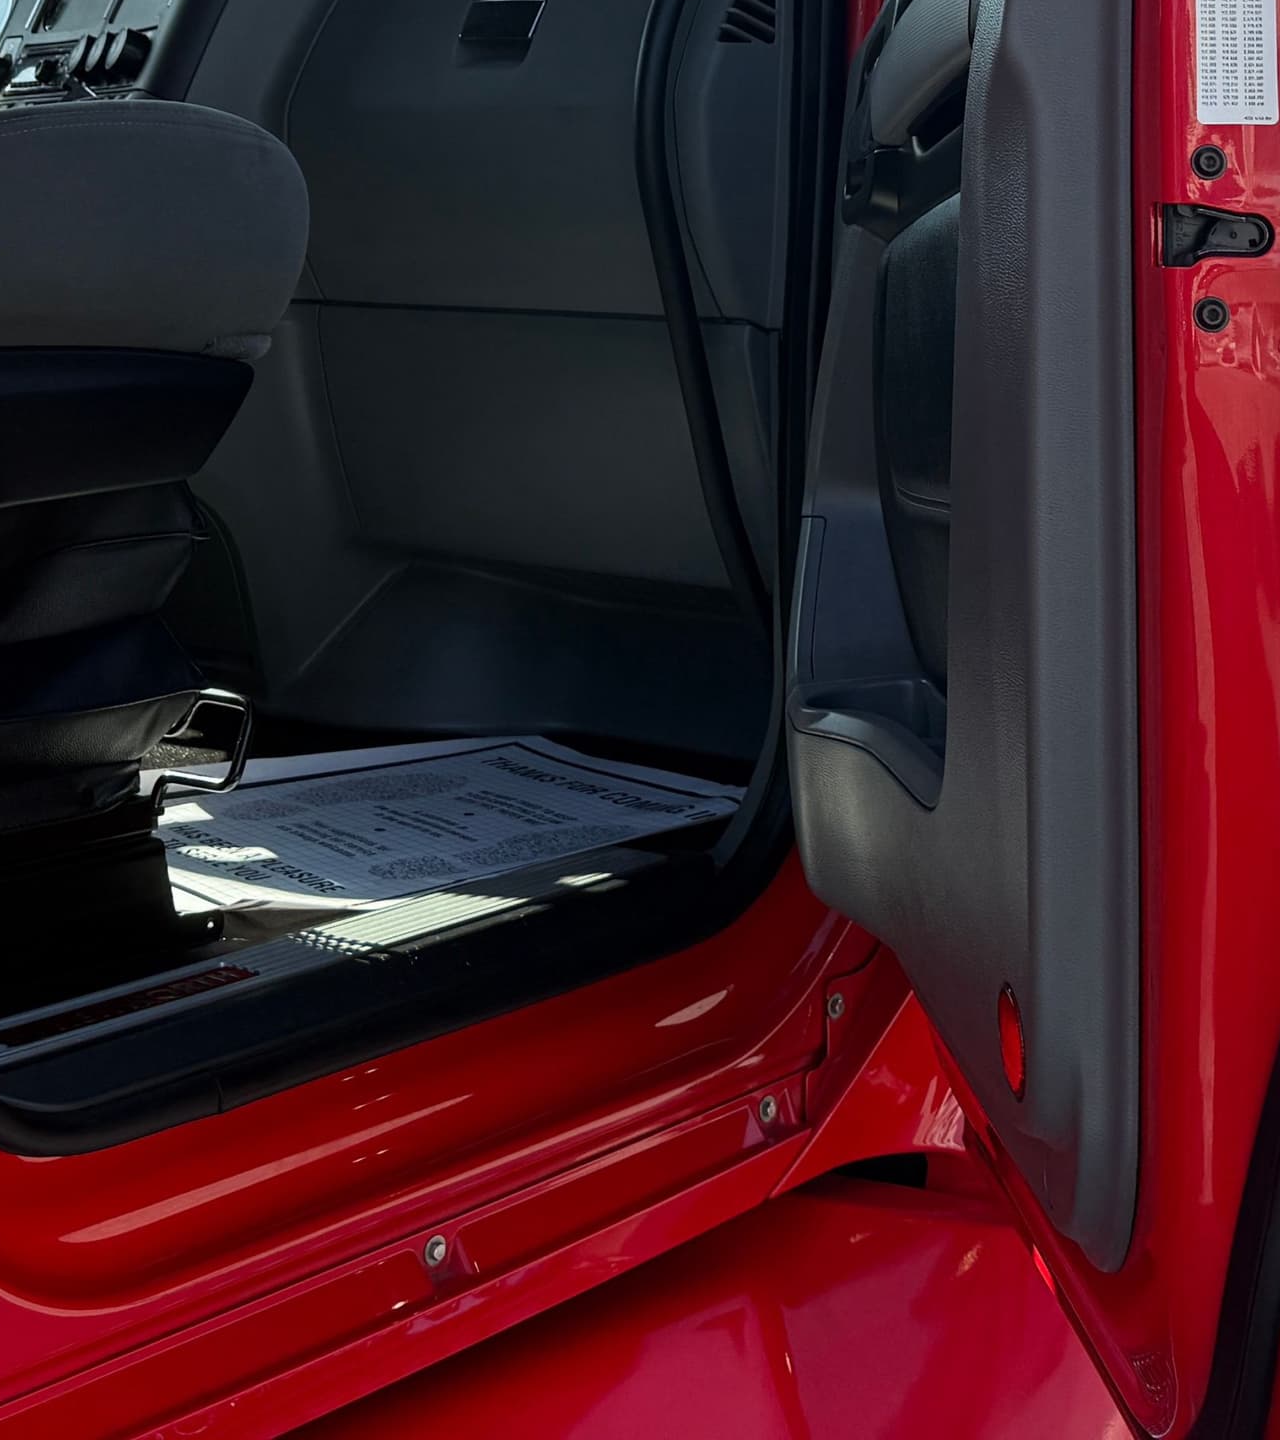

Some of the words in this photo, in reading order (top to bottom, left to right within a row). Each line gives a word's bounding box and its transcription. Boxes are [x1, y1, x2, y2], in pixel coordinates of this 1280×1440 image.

[481, 756, 566, 786] THANKS
[559, 780, 608, 795] FOR
[600, 791, 695, 814] COMING
[164, 838, 187, 849] TO
[226, 864, 273, 881] YOU
[170, 824, 210, 839] HAS
[256, 857, 346, 893] PLEASURE
